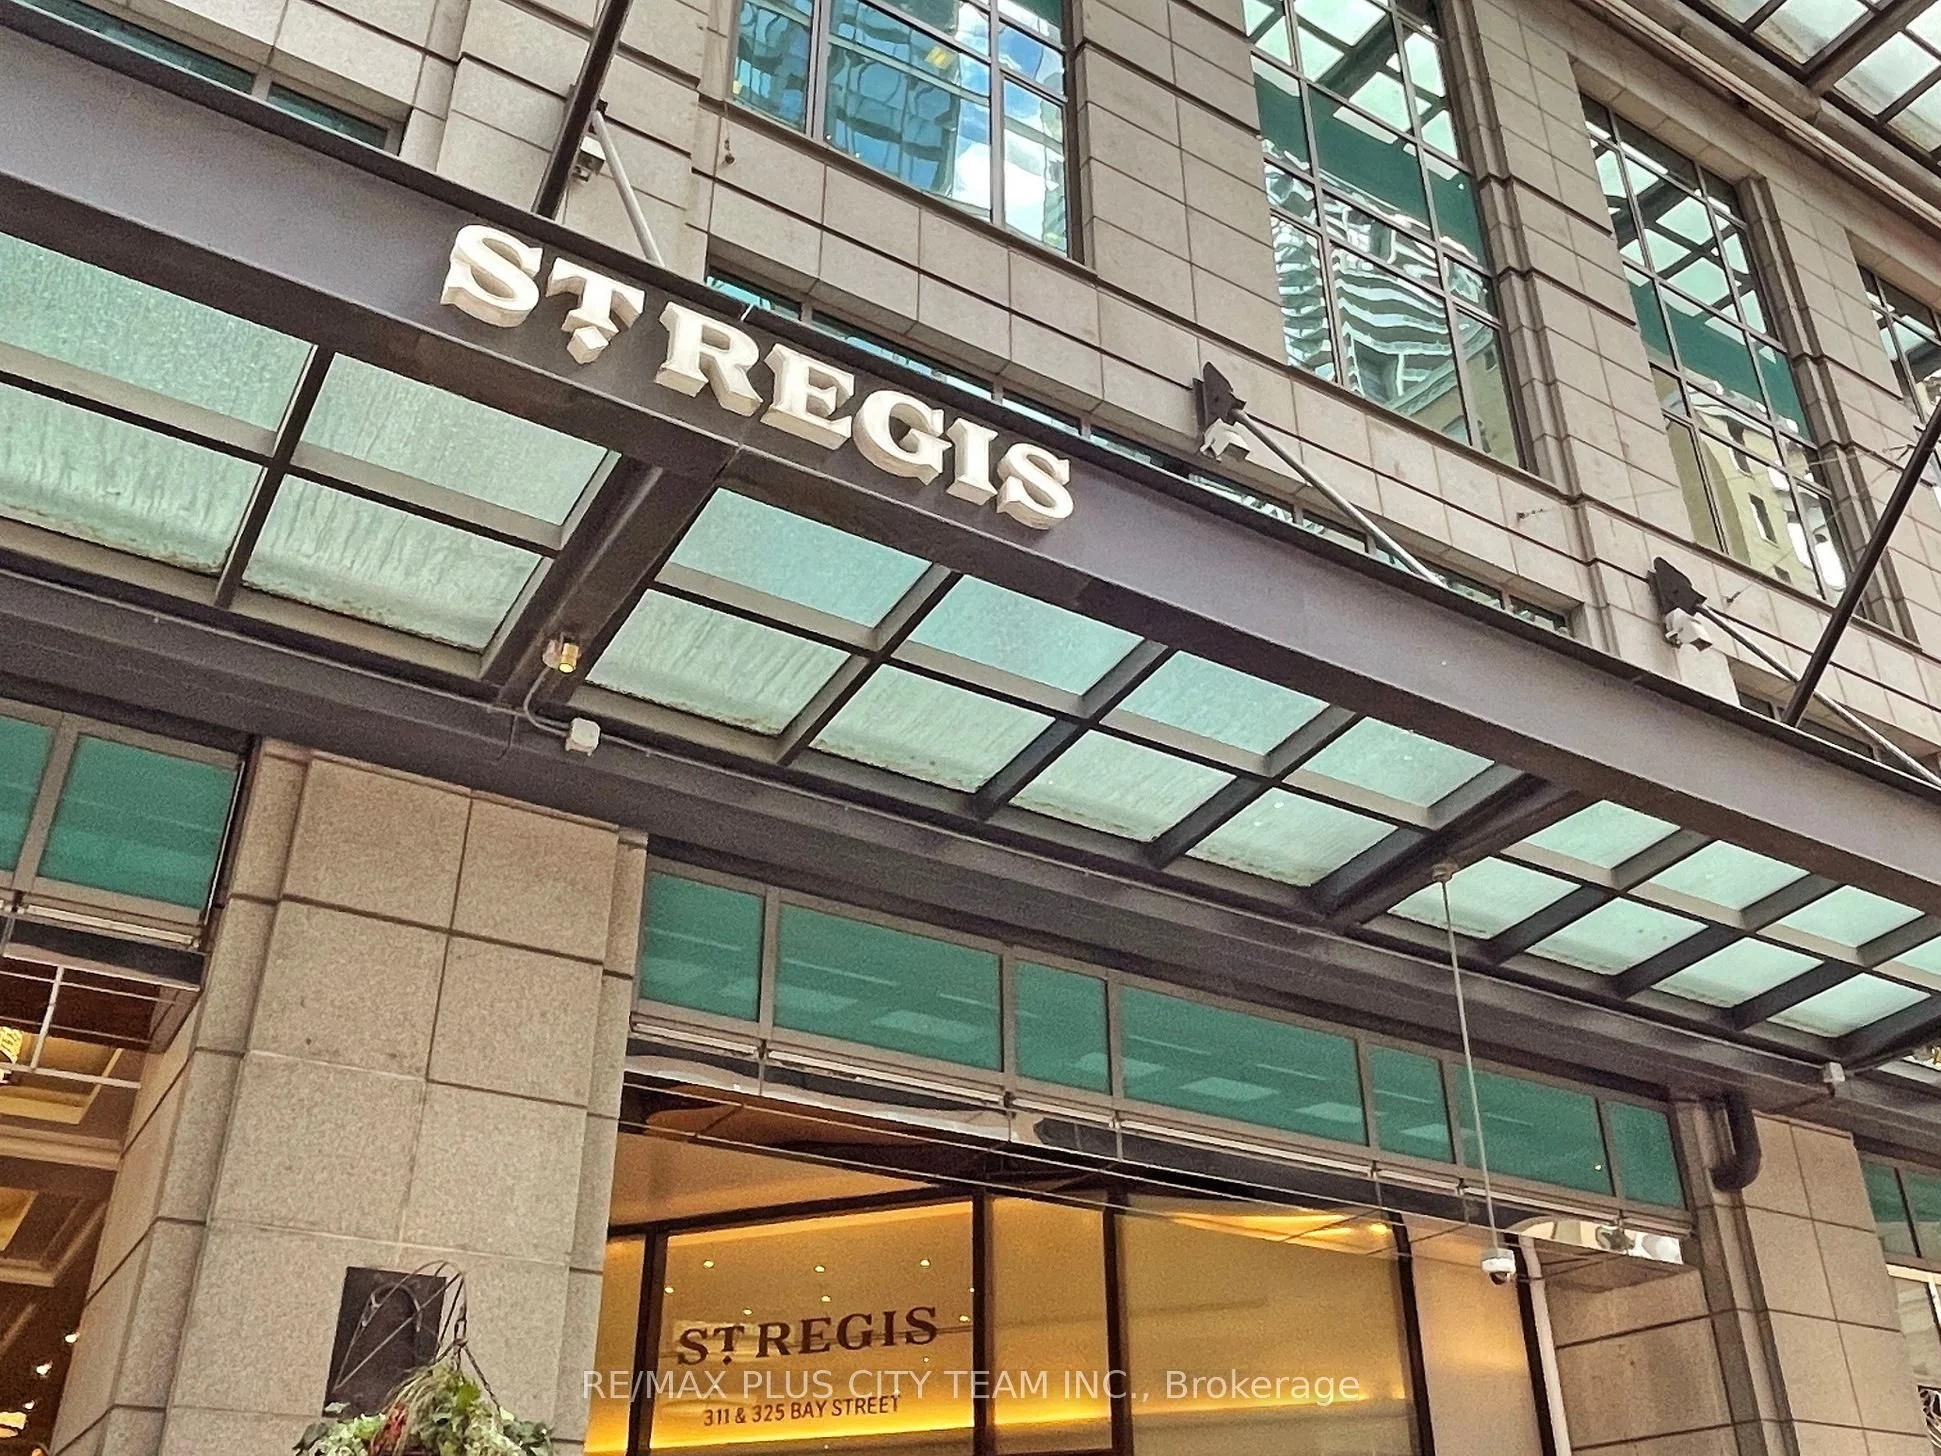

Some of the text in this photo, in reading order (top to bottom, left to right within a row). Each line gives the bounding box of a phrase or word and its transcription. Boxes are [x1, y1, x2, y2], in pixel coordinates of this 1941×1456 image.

[655, 300, 1074, 530] REGIS
[757, 1306, 938, 1358] REGIS
[704, 1394, 901, 1426] 311 & 325 BAY STREET
